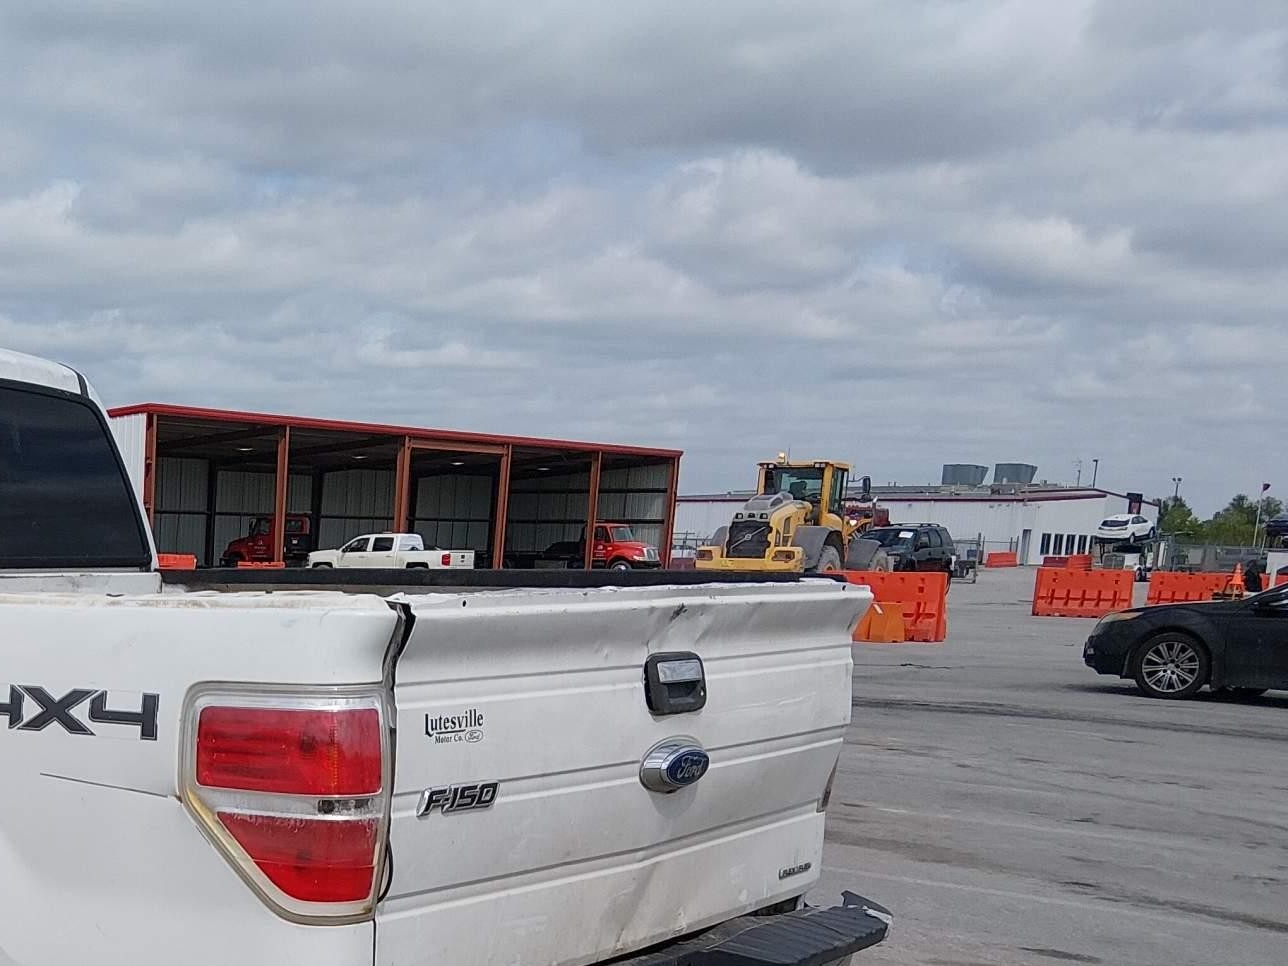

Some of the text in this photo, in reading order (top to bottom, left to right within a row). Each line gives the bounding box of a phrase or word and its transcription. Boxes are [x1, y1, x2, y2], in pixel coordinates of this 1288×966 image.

[424, 708, 484, 738] Lutesville
[434, 730, 482, 744] Motor Co. Ford
[674, 754, 708, 781] Ford
[417, 781, 500, 817] F-150
